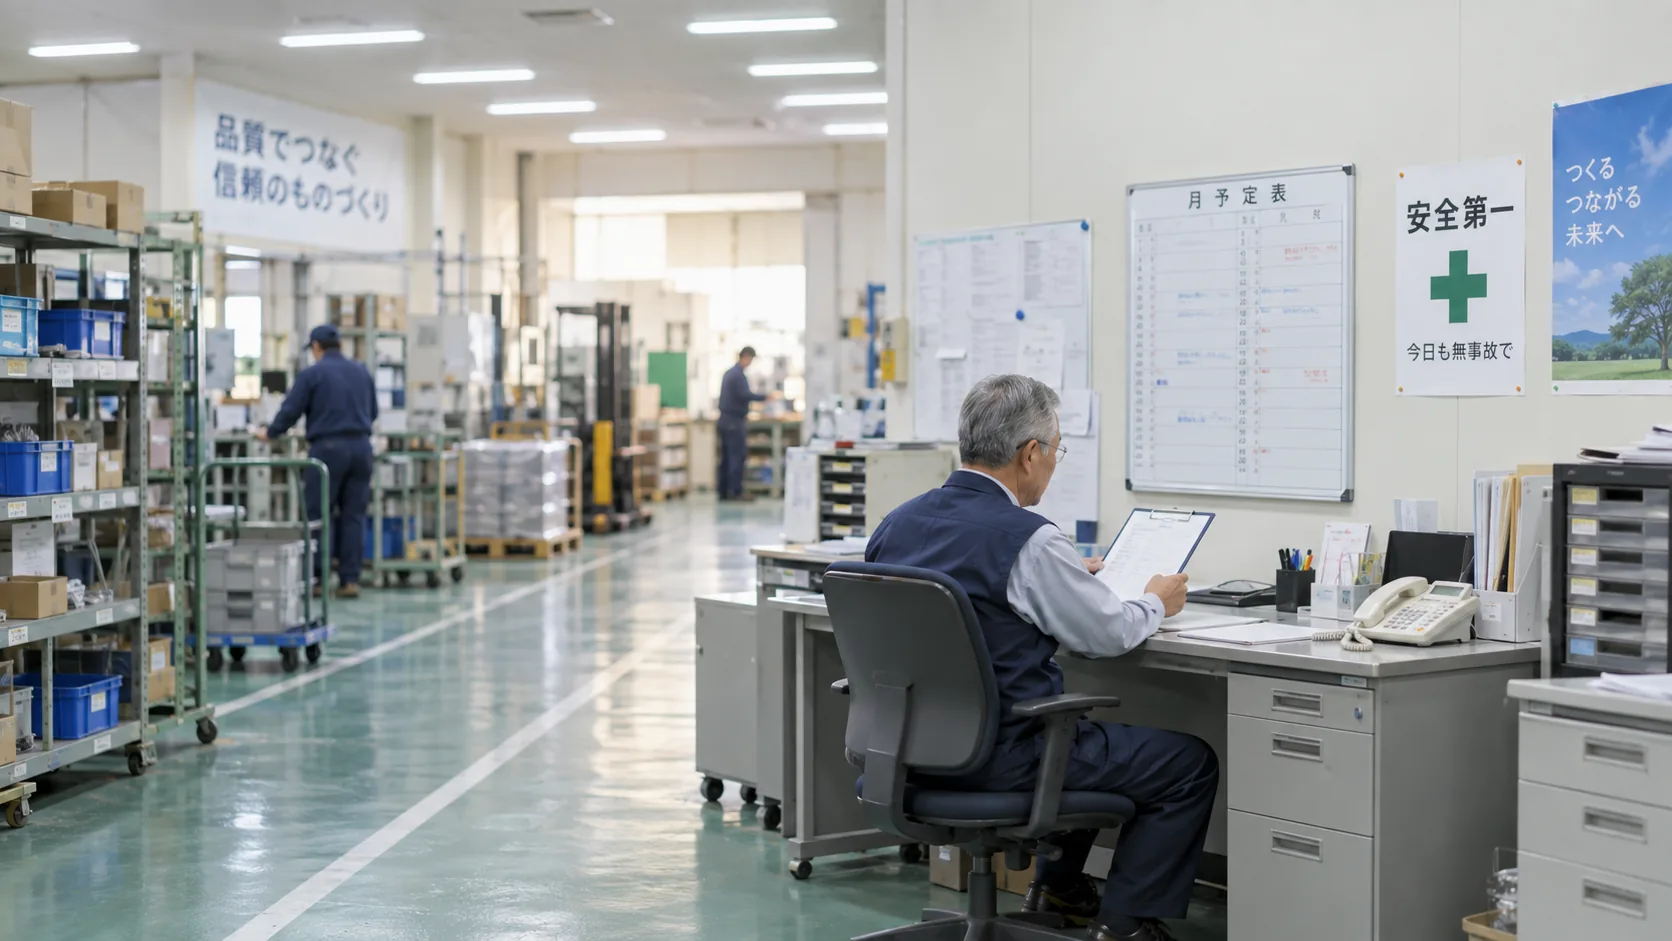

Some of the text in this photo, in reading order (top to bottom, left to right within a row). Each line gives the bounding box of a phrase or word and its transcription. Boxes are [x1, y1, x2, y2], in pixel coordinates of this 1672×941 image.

[215, 113, 360, 177] 品質でつなぐ
[1566, 157, 1615, 182] つくる
[213, 161, 389, 223] 信頼のものづくり
[1188, 183, 1287, 209] 月予定表
[1566, 185, 1642, 214] つながる
[1407, 195, 1514, 234] 安全第一
[1565, 221, 1625, 248] 未来へ
[1407, 341, 1514, 361] 今日も無事故で
